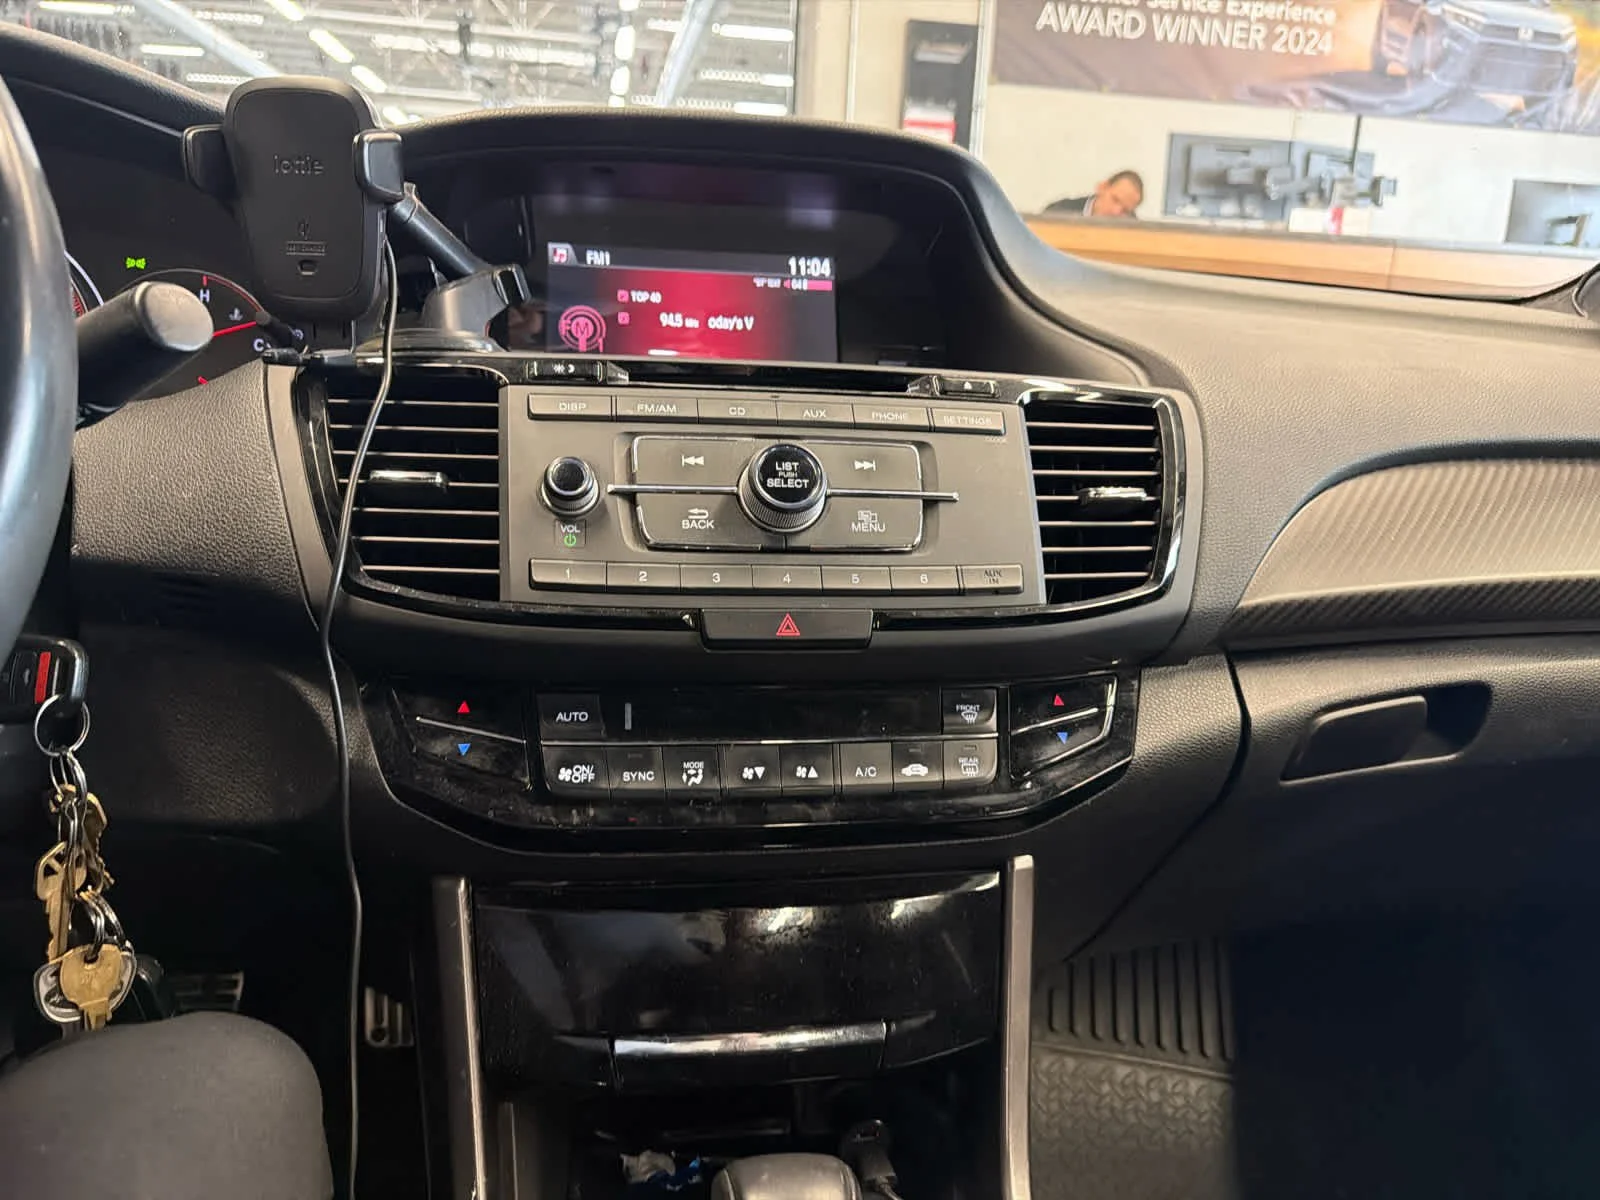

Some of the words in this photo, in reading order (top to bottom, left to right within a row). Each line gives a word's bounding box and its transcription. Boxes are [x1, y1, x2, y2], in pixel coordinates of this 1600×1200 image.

[1226, 0, 1337, 25] Experience
[1035, 2, 1146, 39] AWARD
[1152, 12, 1267, 51] WINNER
[1272, 24, 1334, 56] 2024
[585, 249, 610, 266] FM1
[787, 256, 831, 277] 11:04
[200, 288, 210, 302] H
[630, 290, 650, 303] TOP
[558, 402, 587, 412] DISP
[636, 403, 678, 414] FM/AM
[729, 406, 746, 416] CD
[803, 409, 827, 418] AUX
[871, 411, 908, 422] PHONE
[943, 415, 992, 425] SETTINGS
[775, 461, 799, 471] LIST
[767, 478, 809, 489] SELECT
[560, 524, 581, 533] VOL
[681, 519, 715, 530] BACK
[851, 522, 886, 533] MENU
[565, 568, 571, 579] 1
[638, 571, 648, 582] 2
[711, 572, 721, 583] 3
[781, 573, 792, 584] 4
[850, 573, 860, 584] 5
[919, 573, 929, 584] 6
[956, 704, 980, 712] FRONT
[555, 711, 589, 722] AUTO
[572, 765, 594, 774] ON/
[682, 761, 704, 769] MODE
[622, 771, 655, 782] SYNC
[855, 766, 877, 778] A/C
[571, 773, 596, 783] OFF
